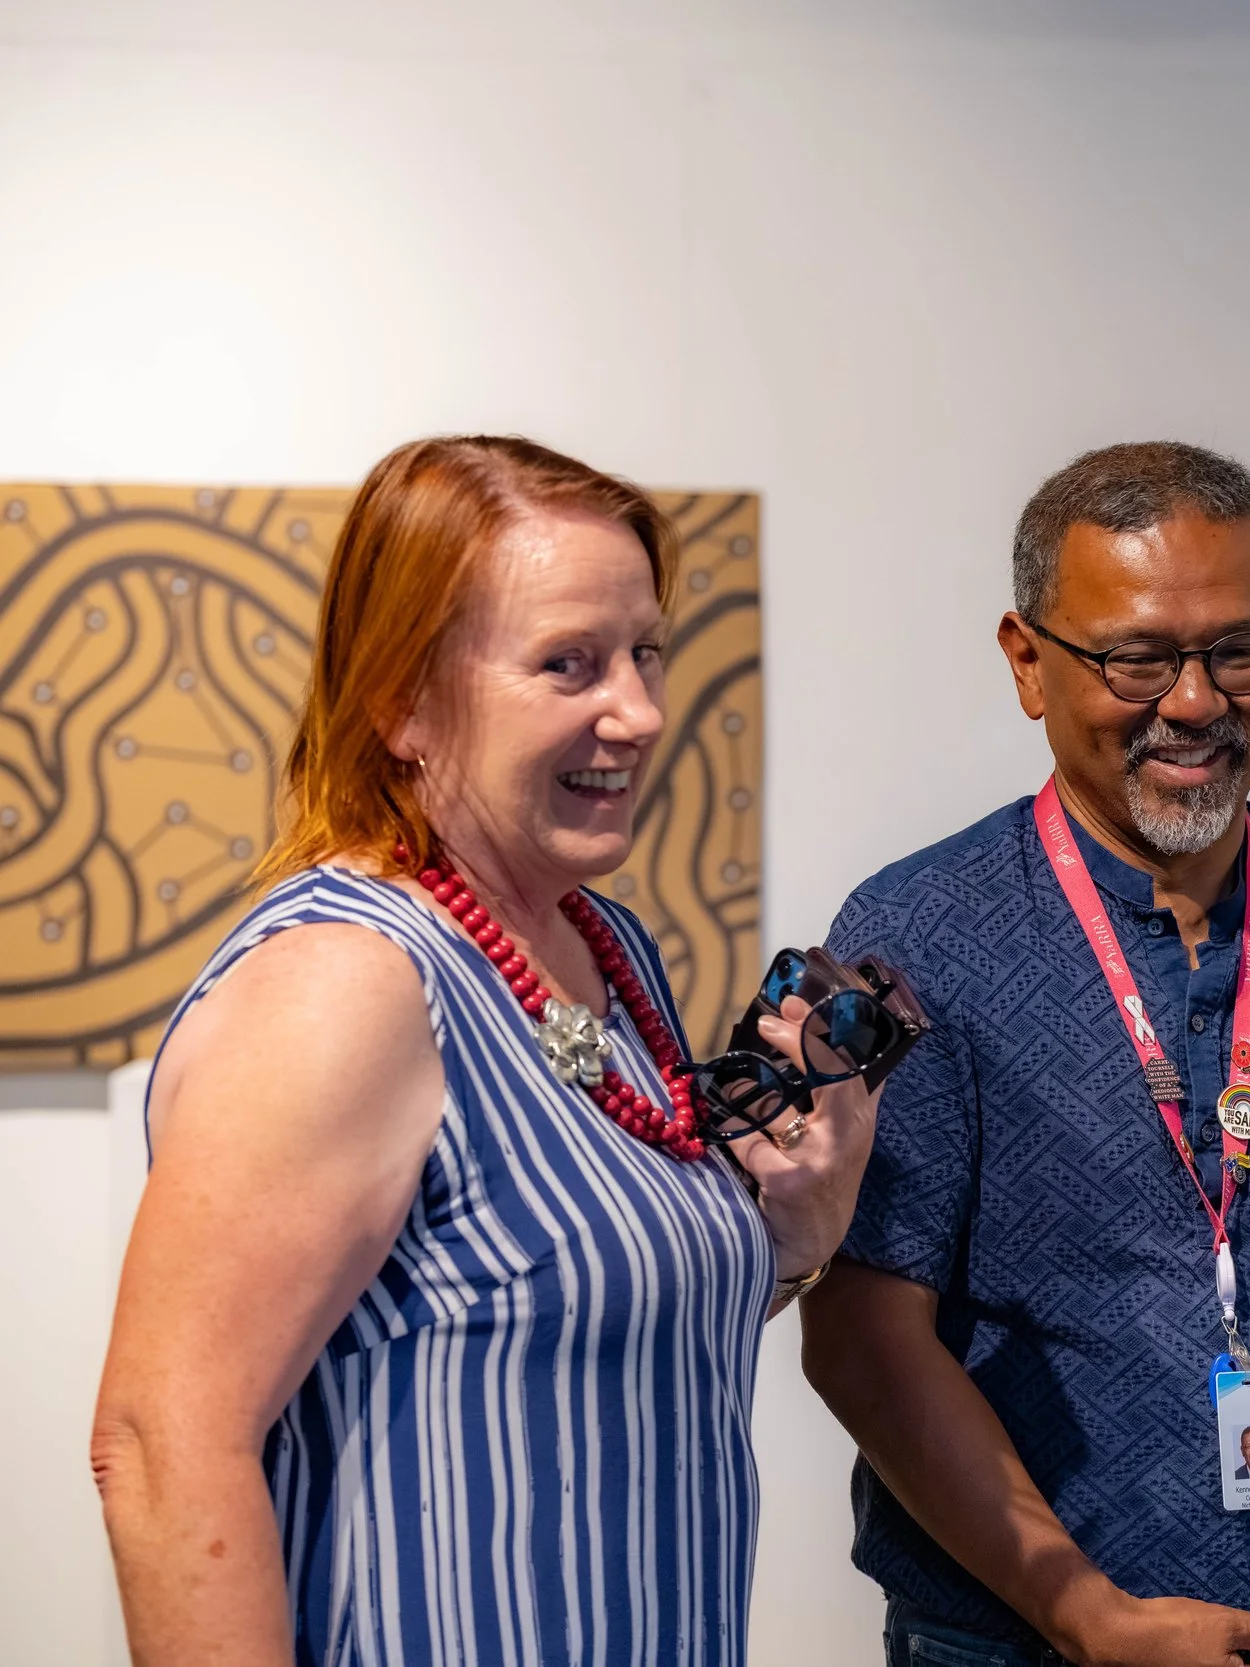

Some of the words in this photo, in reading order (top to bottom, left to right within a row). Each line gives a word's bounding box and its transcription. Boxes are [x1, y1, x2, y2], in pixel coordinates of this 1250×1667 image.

[1224, 1109, 1234, 1117] YOU
[1224, 1116, 1234, 1124] ARE
[1231, 1126, 1244, 1134] WITH
